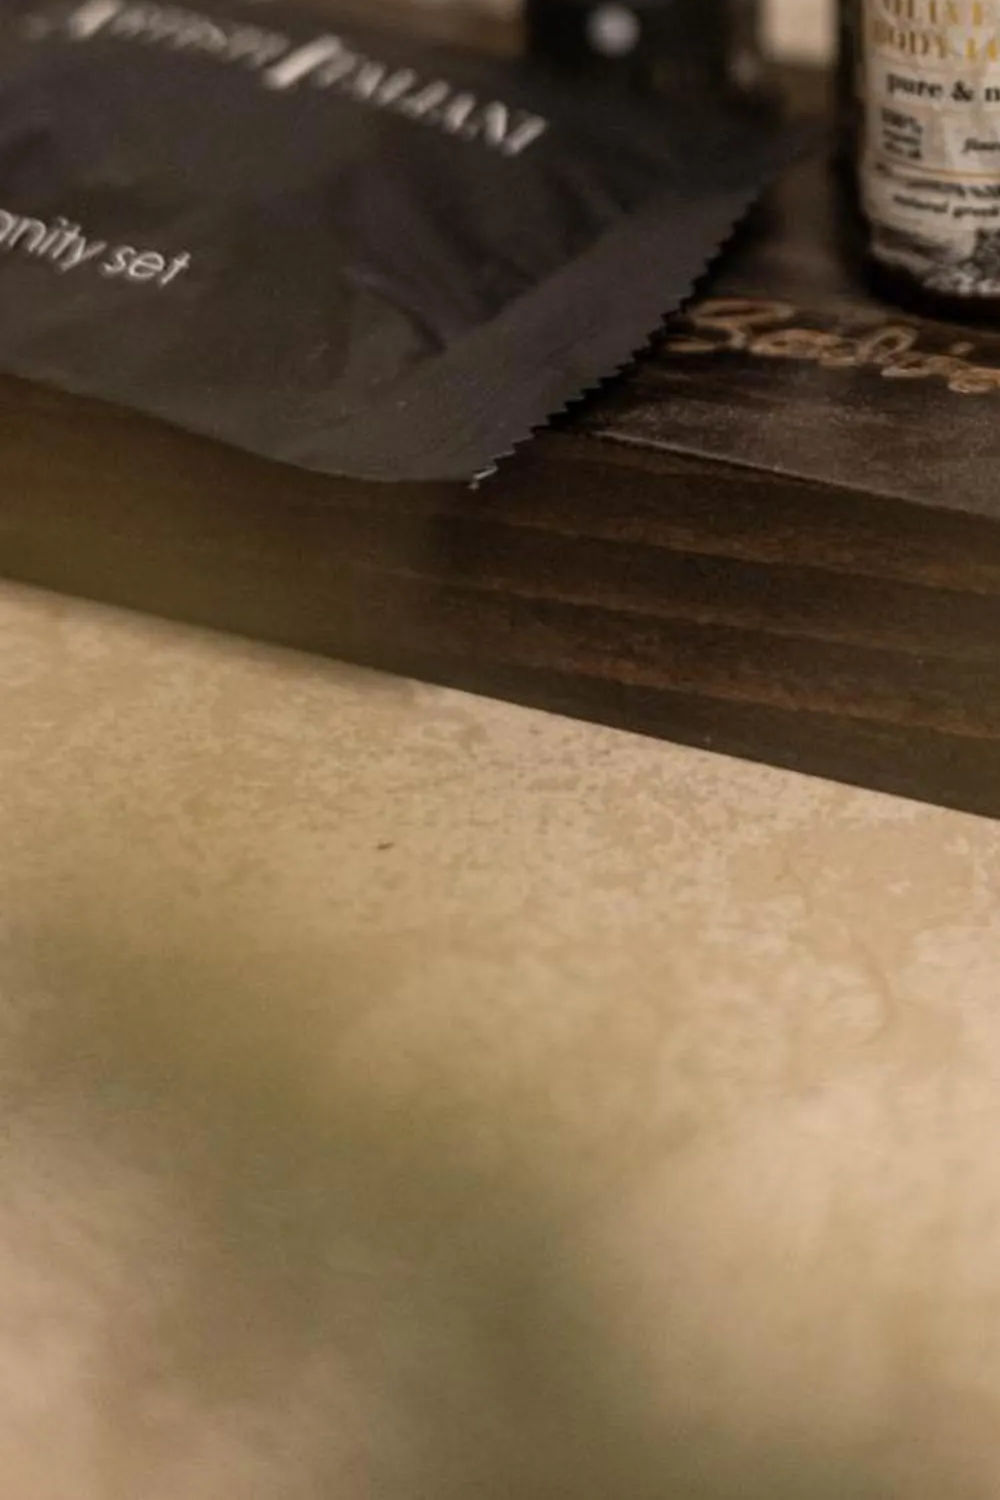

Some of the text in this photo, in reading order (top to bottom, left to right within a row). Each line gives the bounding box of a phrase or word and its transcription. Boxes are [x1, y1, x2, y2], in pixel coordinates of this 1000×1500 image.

[885, 72, 943, 99] pure
[951, 79, 975, 102] &
[100, 243, 192, 289] set
